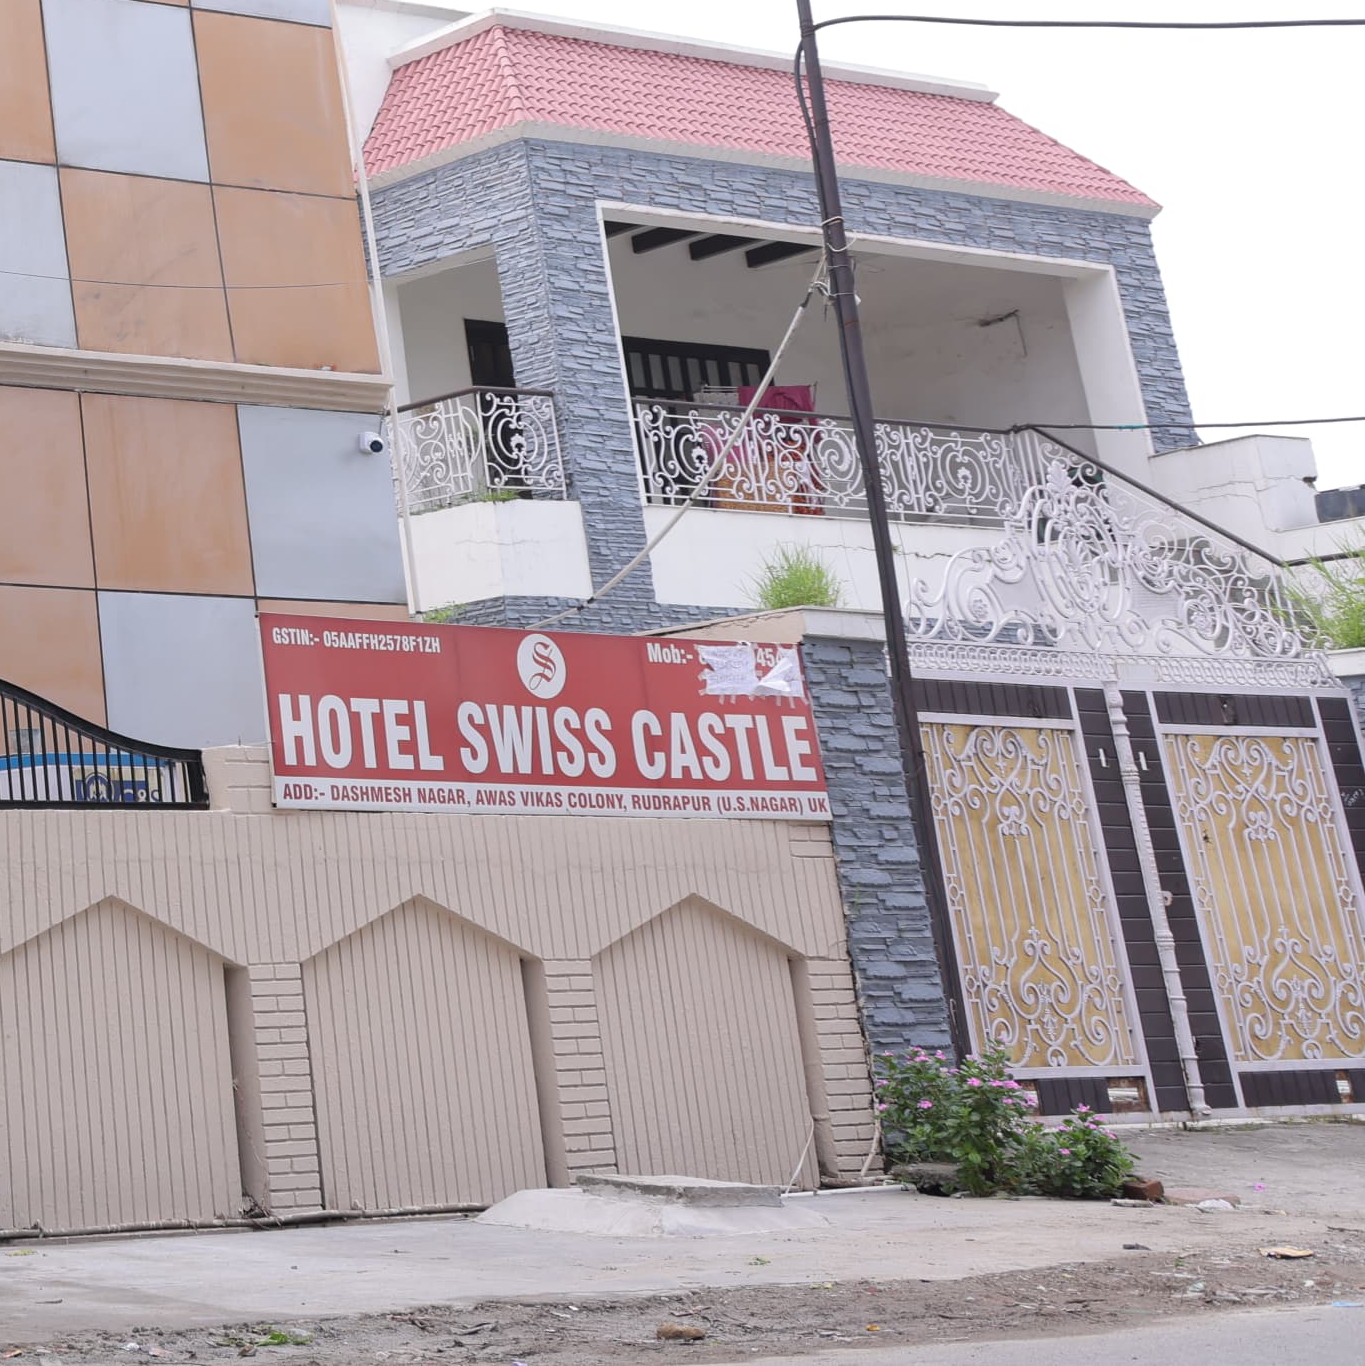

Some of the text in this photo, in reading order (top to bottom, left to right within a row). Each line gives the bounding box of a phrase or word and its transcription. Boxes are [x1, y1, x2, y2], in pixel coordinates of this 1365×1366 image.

[272, 627, 319, 646] GSTIN:-
[646, 642, 693, 664] Mob:-
[278, 693, 817, 782] HOTEL SWISS CASTLE
[283, 783, 828, 815] ADD:- DASHMESH NAGAR, AWAS VIKAS COLONY, RUDRAPUR (U.S.NAGAR) UK
